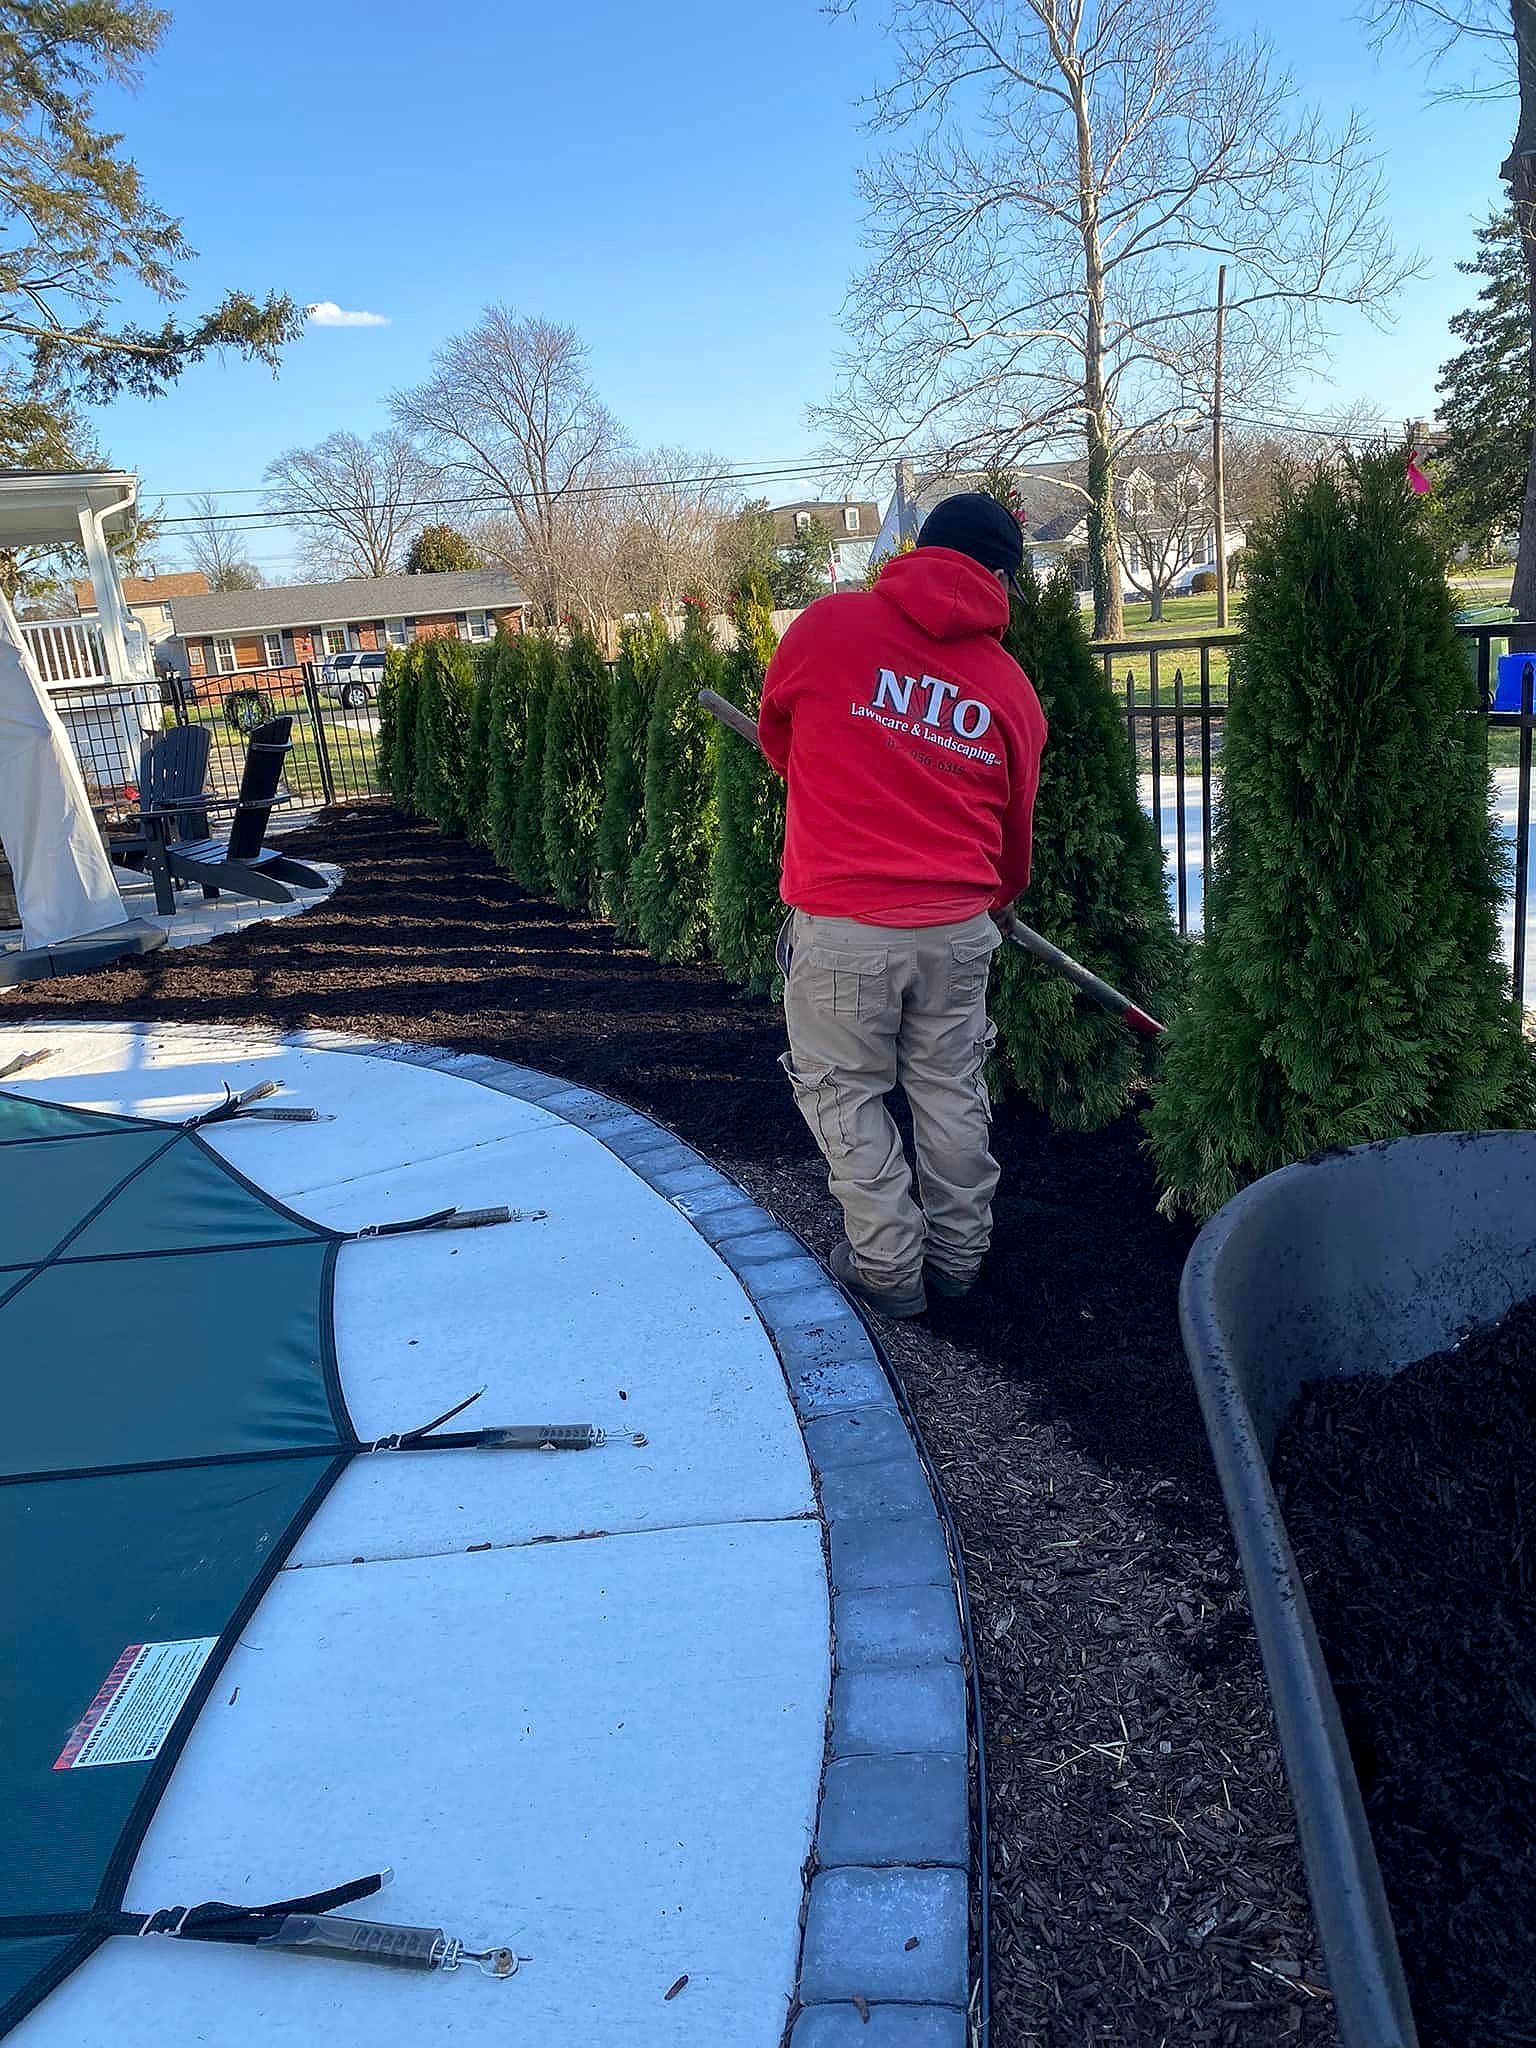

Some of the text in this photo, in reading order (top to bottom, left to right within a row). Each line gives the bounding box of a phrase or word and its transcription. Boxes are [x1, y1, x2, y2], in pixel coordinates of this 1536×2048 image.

[851, 702, 909, 733] Lawncare
[911, 723, 921, 737] &
[923, 727, 996, 765] Landscaping
[871, 667, 991, 740] NTO
[77, 1729, 104, 1763] AVOID
[98, 1671, 138, 1727] DROWNING
